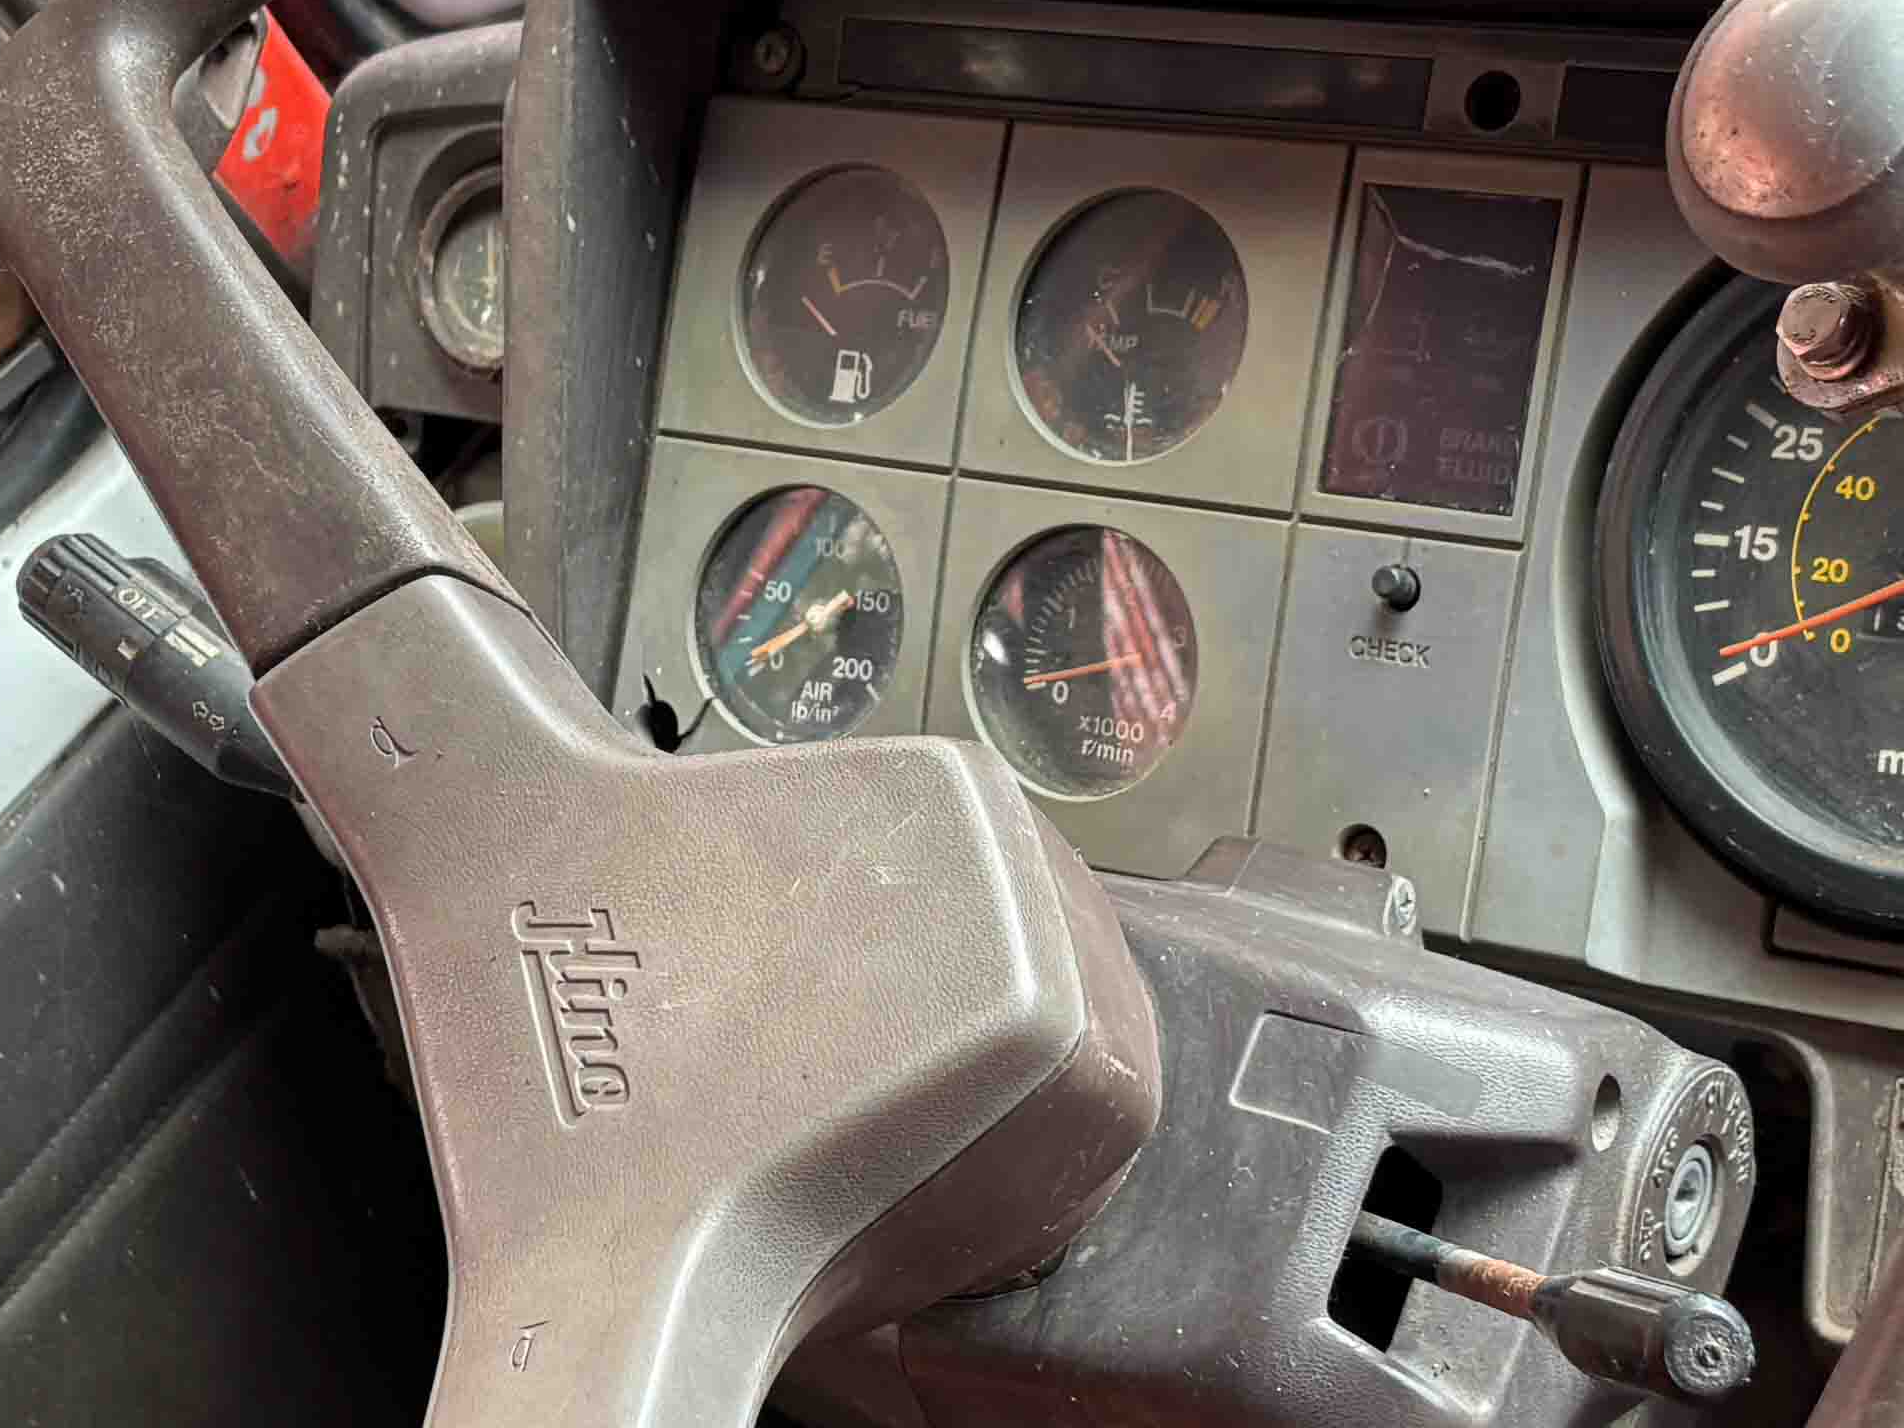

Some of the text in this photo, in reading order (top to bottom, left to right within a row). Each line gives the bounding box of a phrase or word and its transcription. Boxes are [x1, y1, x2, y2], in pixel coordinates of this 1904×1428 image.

[817, 243, 833, 265] E
[1771, 424, 1825, 462] 25
[1835, 476, 1877, 501] 40
[816, 537, 848, 559] 100
[1734, 525, 1779, 562] 15
[1810, 557, 1850, 584] 20
[764, 581, 792, 604] 50
[855, 590, 891, 613] 150
[1351, 635, 1432, 668] CHECK
[1749, 632, 1780, 669] 0
[1830, 627, 1853, 654] 0
[768, 652, 785, 670] 0
[832, 656, 874, 681] 200
[800, 682, 834, 701] AIR
[1052, 681, 1070, 705] 0
[1081, 738, 1136, 764] r/min
